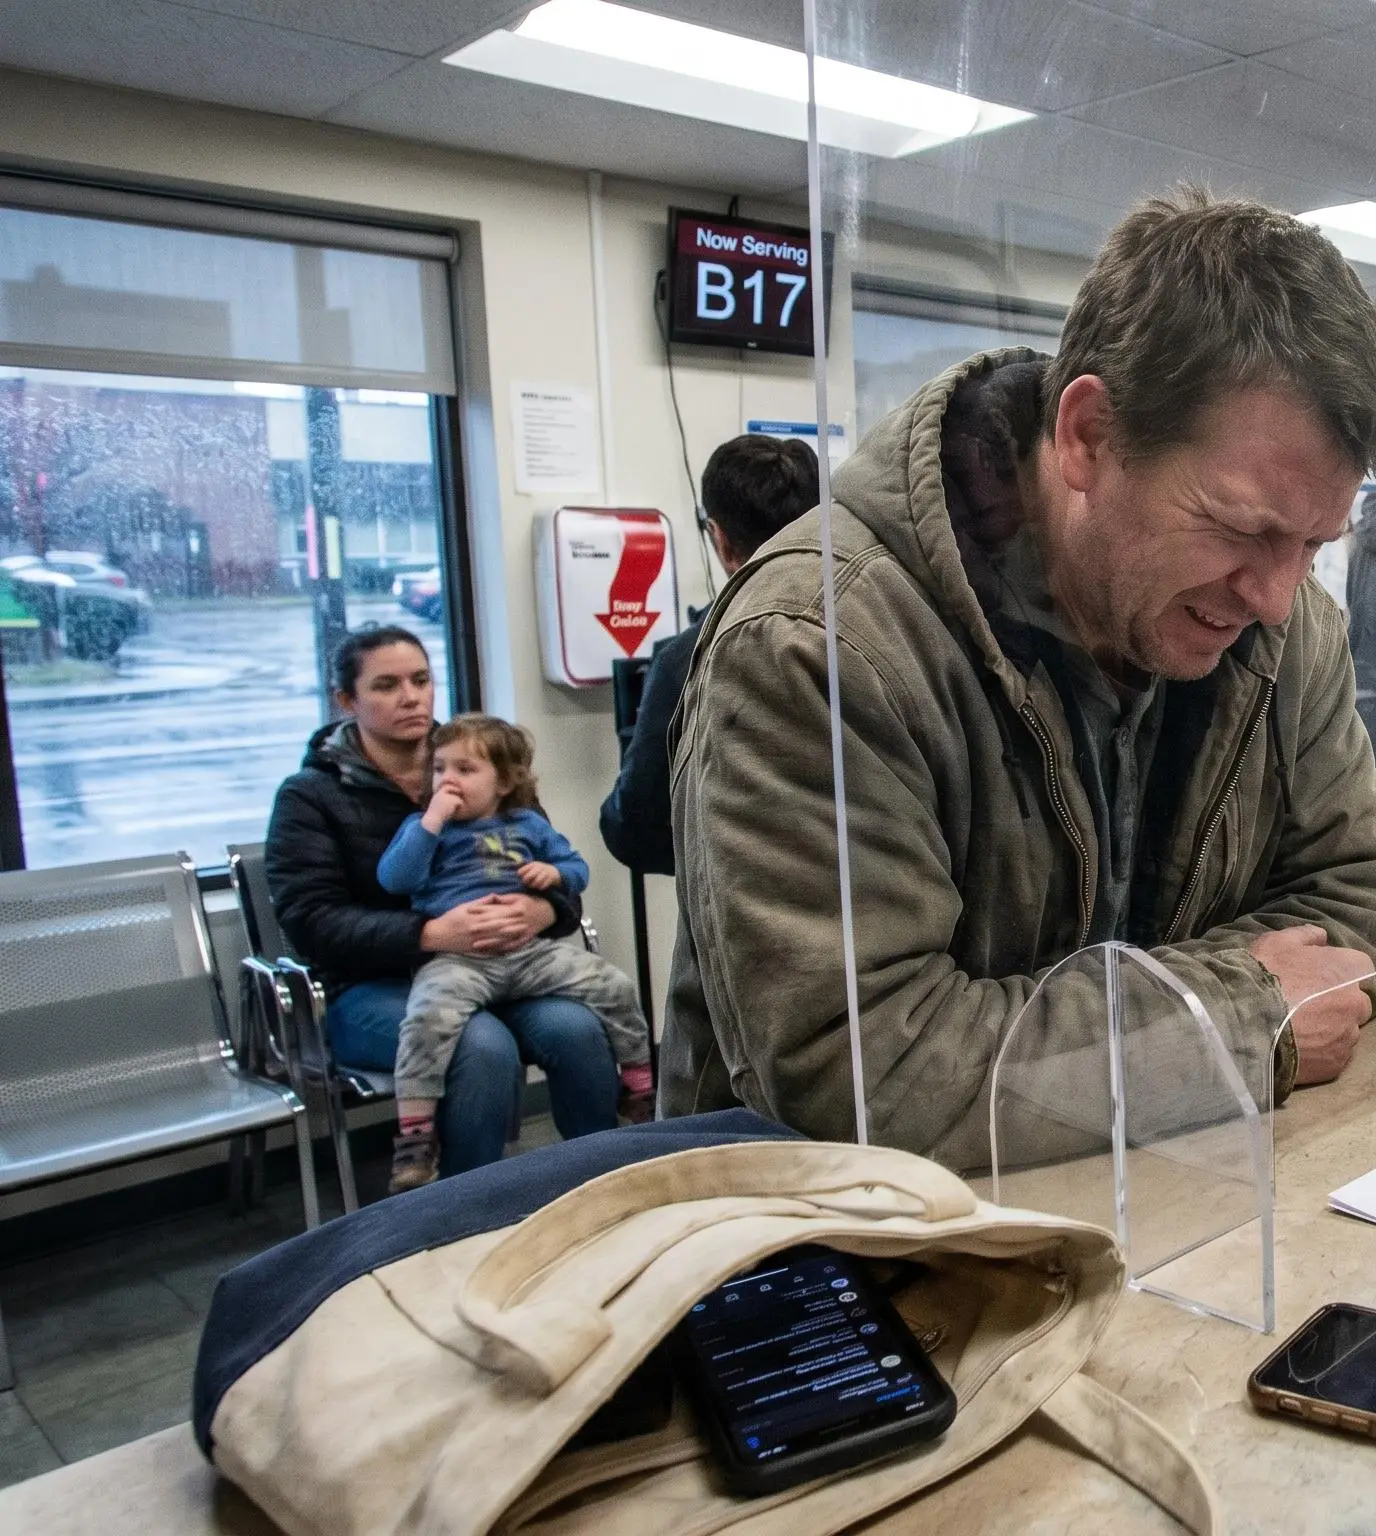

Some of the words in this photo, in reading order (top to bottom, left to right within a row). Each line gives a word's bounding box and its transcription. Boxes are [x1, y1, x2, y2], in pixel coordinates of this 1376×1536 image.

[696, 227, 738, 252] Now
[742, 235, 808, 267] Serving
[696, 261, 807, 328] B17
